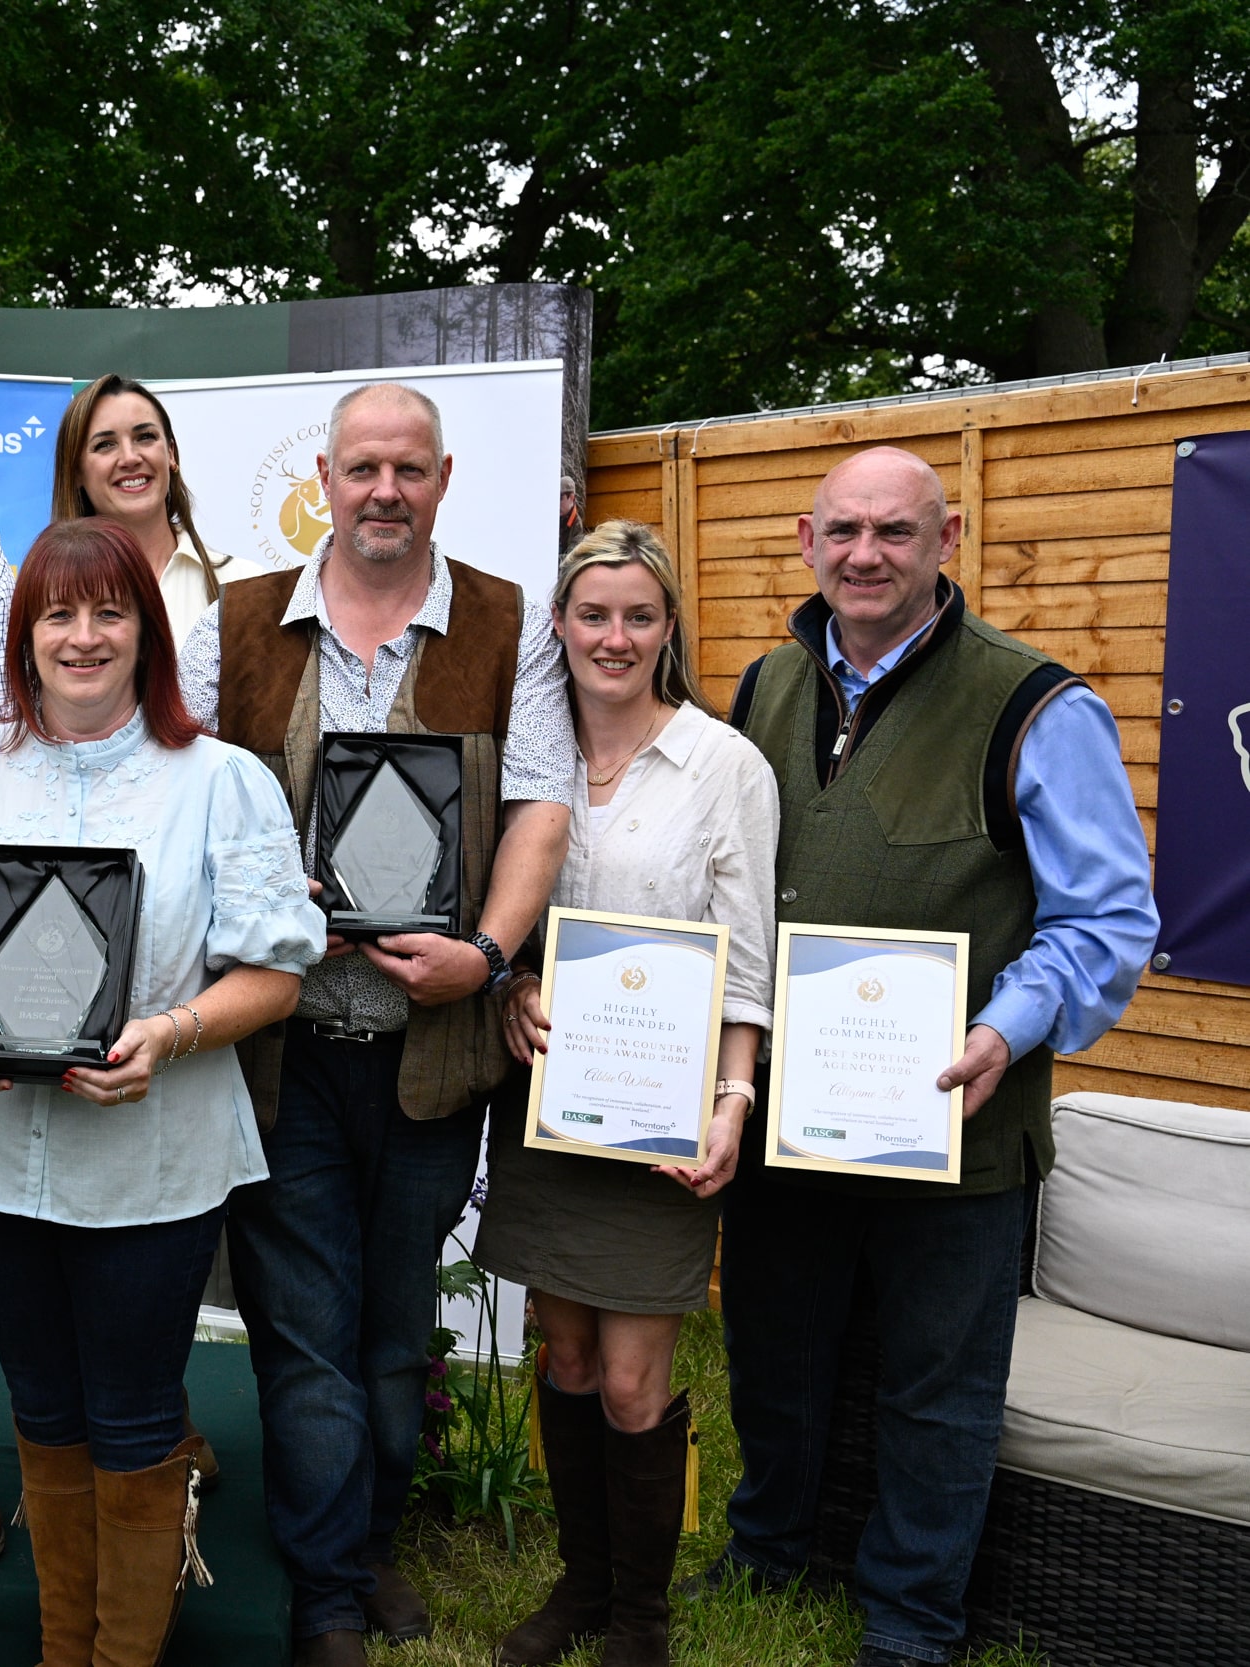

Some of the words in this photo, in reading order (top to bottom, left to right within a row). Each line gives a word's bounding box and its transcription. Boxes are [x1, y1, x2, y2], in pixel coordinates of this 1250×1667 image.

[250, 436, 294, 518] SCOTTISH
[257, 536, 295, 571] TOUR
[19, 1011, 47, 1020] BASC
[603, 1003, 658, 1017] HIGHLY
[582, 1013, 677, 1031] COMMENDED
[841, 1016, 898, 1028] HIGHLY
[819, 1027, 919, 1042] COMMENDED
[564, 1032, 611, 1044] WOMEN
[615, 1038, 628, 1047] IN
[632, 1040, 691, 1054] COUNTRY
[564, 1043, 610, 1055] SPORTS
[613, 1049, 656, 1061] AWARD
[661, 1054, 688, 1064] 2026
[814, 1048, 847, 1058] BEST
[852, 1051, 922, 1065] SPORTING
[821, 1061, 876, 1073] AGENCY
[881, 1066, 912, 1076] 2026
[584, 1067, 616, 1083] Abbie
[617, 1070, 663, 1089] Wilson
[564, 1112, 591, 1123] BASC
[630, 1119, 671, 1131] Thorntons
[806, 1127, 834, 1138] BASC
[875, 1133, 918, 1145] Thorntons
